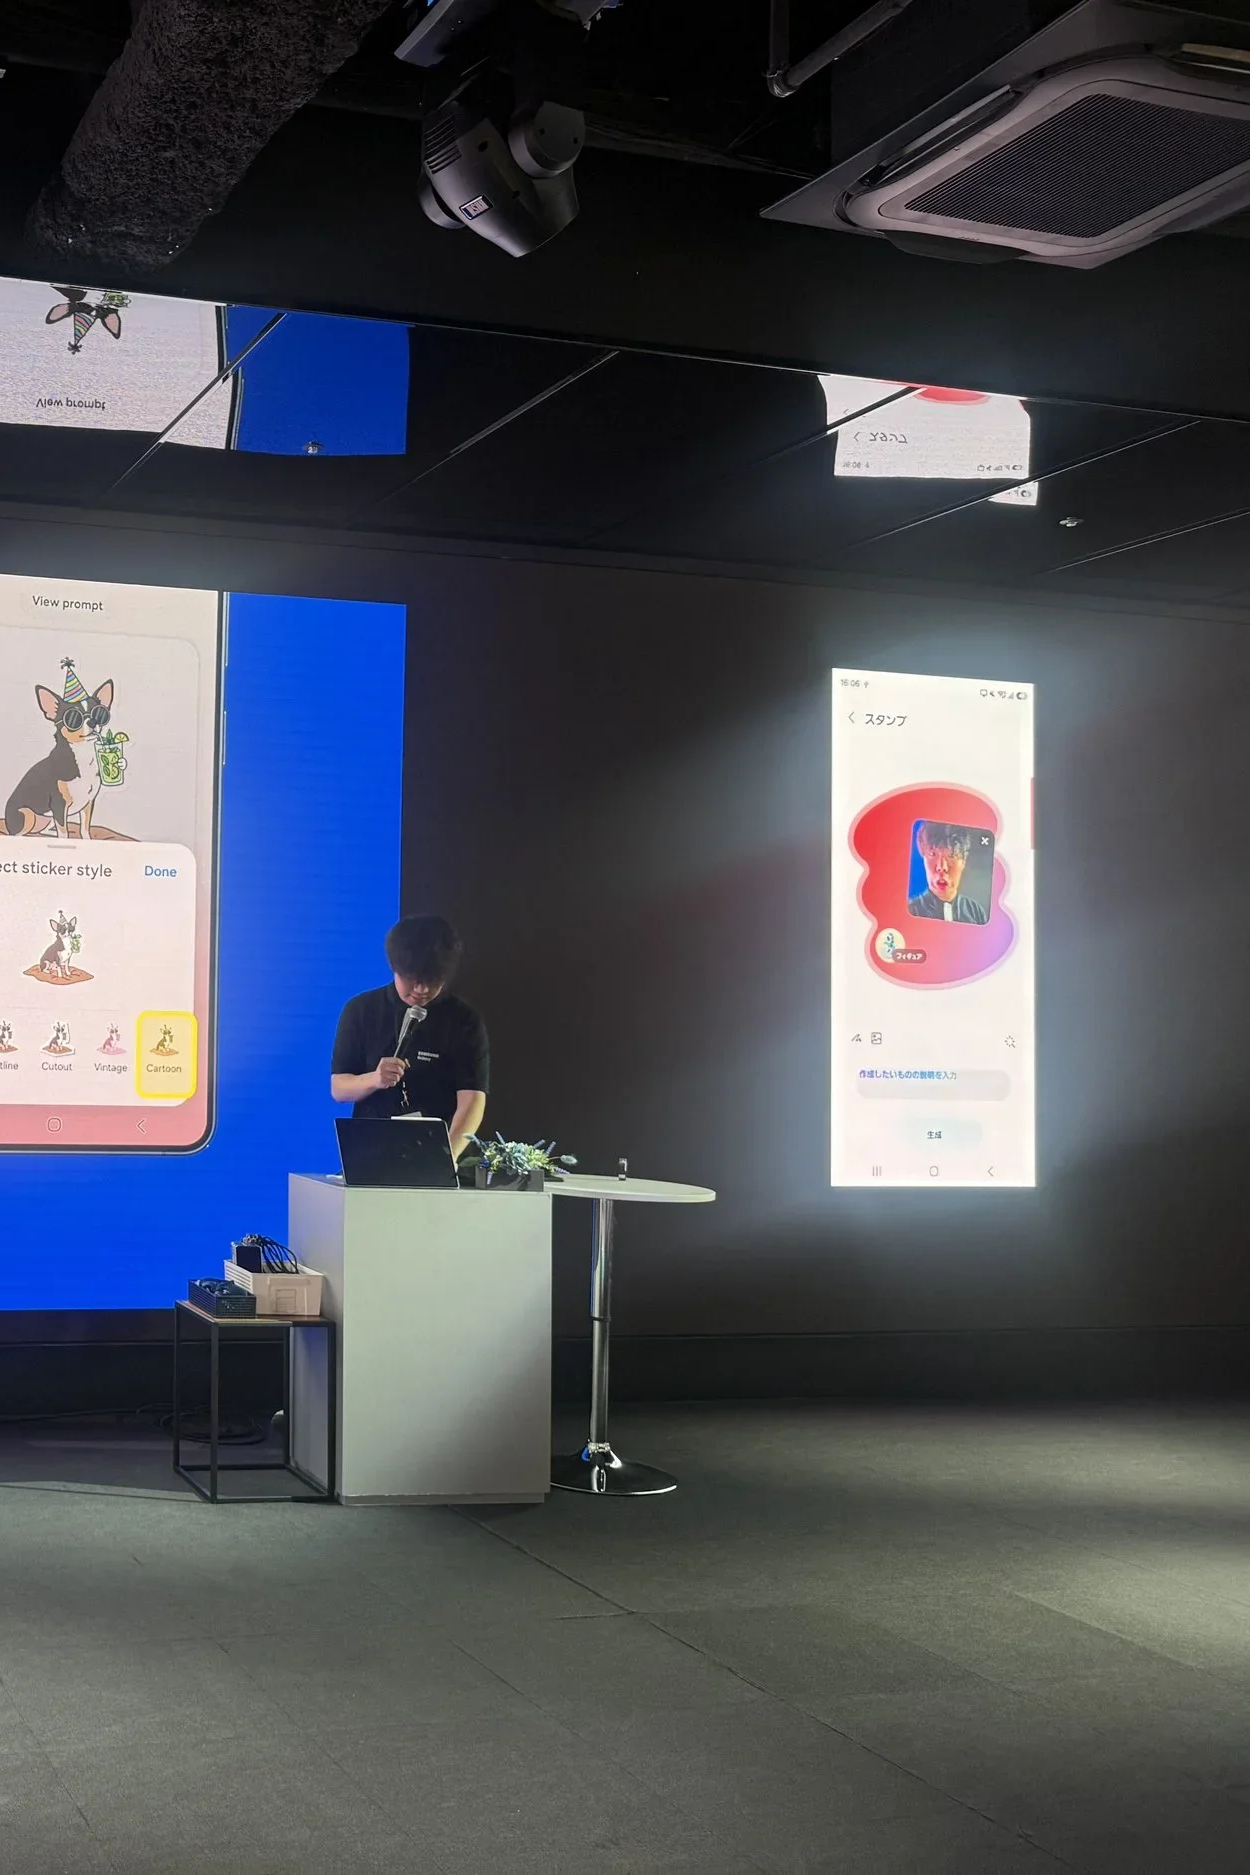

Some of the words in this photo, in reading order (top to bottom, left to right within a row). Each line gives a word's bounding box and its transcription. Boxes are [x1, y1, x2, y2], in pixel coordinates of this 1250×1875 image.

[31, 595, 60, 608] View
[62, 598, 104, 612] prompt
[864, 713, 908, 727] スタンプ
[21, 860, 73, 876] sticker
[76, 863, 112, 881] style
[143, 864, 178, 878] Done
[40, 1061, 73, 1072] Cutout
[93, 1062, 128, 1075] Vintage
[145, 1063, 182, 1074] Cartoon
